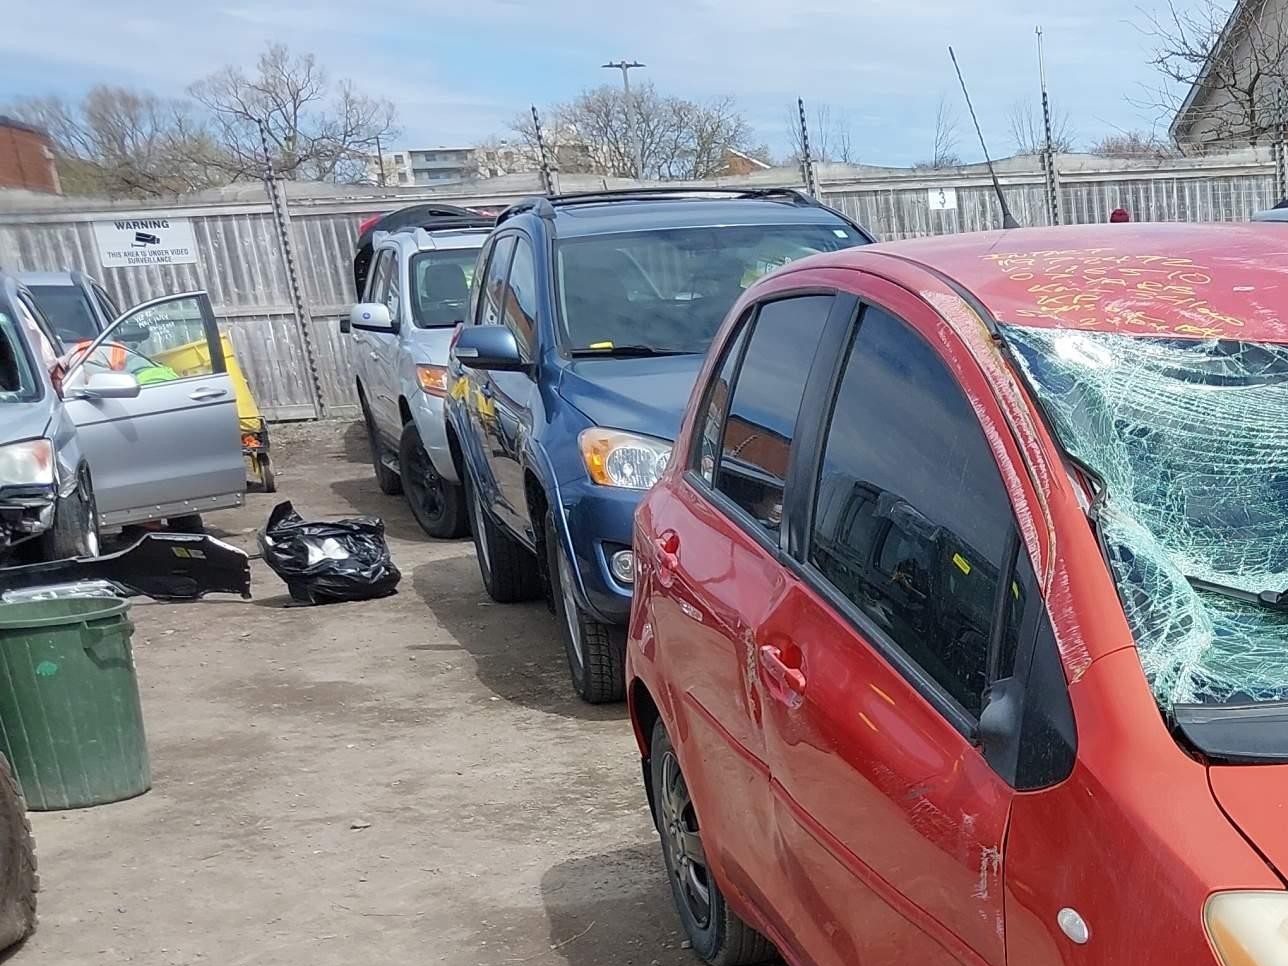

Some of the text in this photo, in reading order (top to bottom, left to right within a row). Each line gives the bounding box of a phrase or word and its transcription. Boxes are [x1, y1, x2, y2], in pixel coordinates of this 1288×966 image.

[114, 219, 170, 231] WARNING
[107, 251, 122, 259] THIS
[123, 250, 139, 258] AREA
[148, 249, 170, 257] UNDER
[170, 248, 189, 256] VIDEO
[127, 255, 173, 264] SURVEILLANCE
